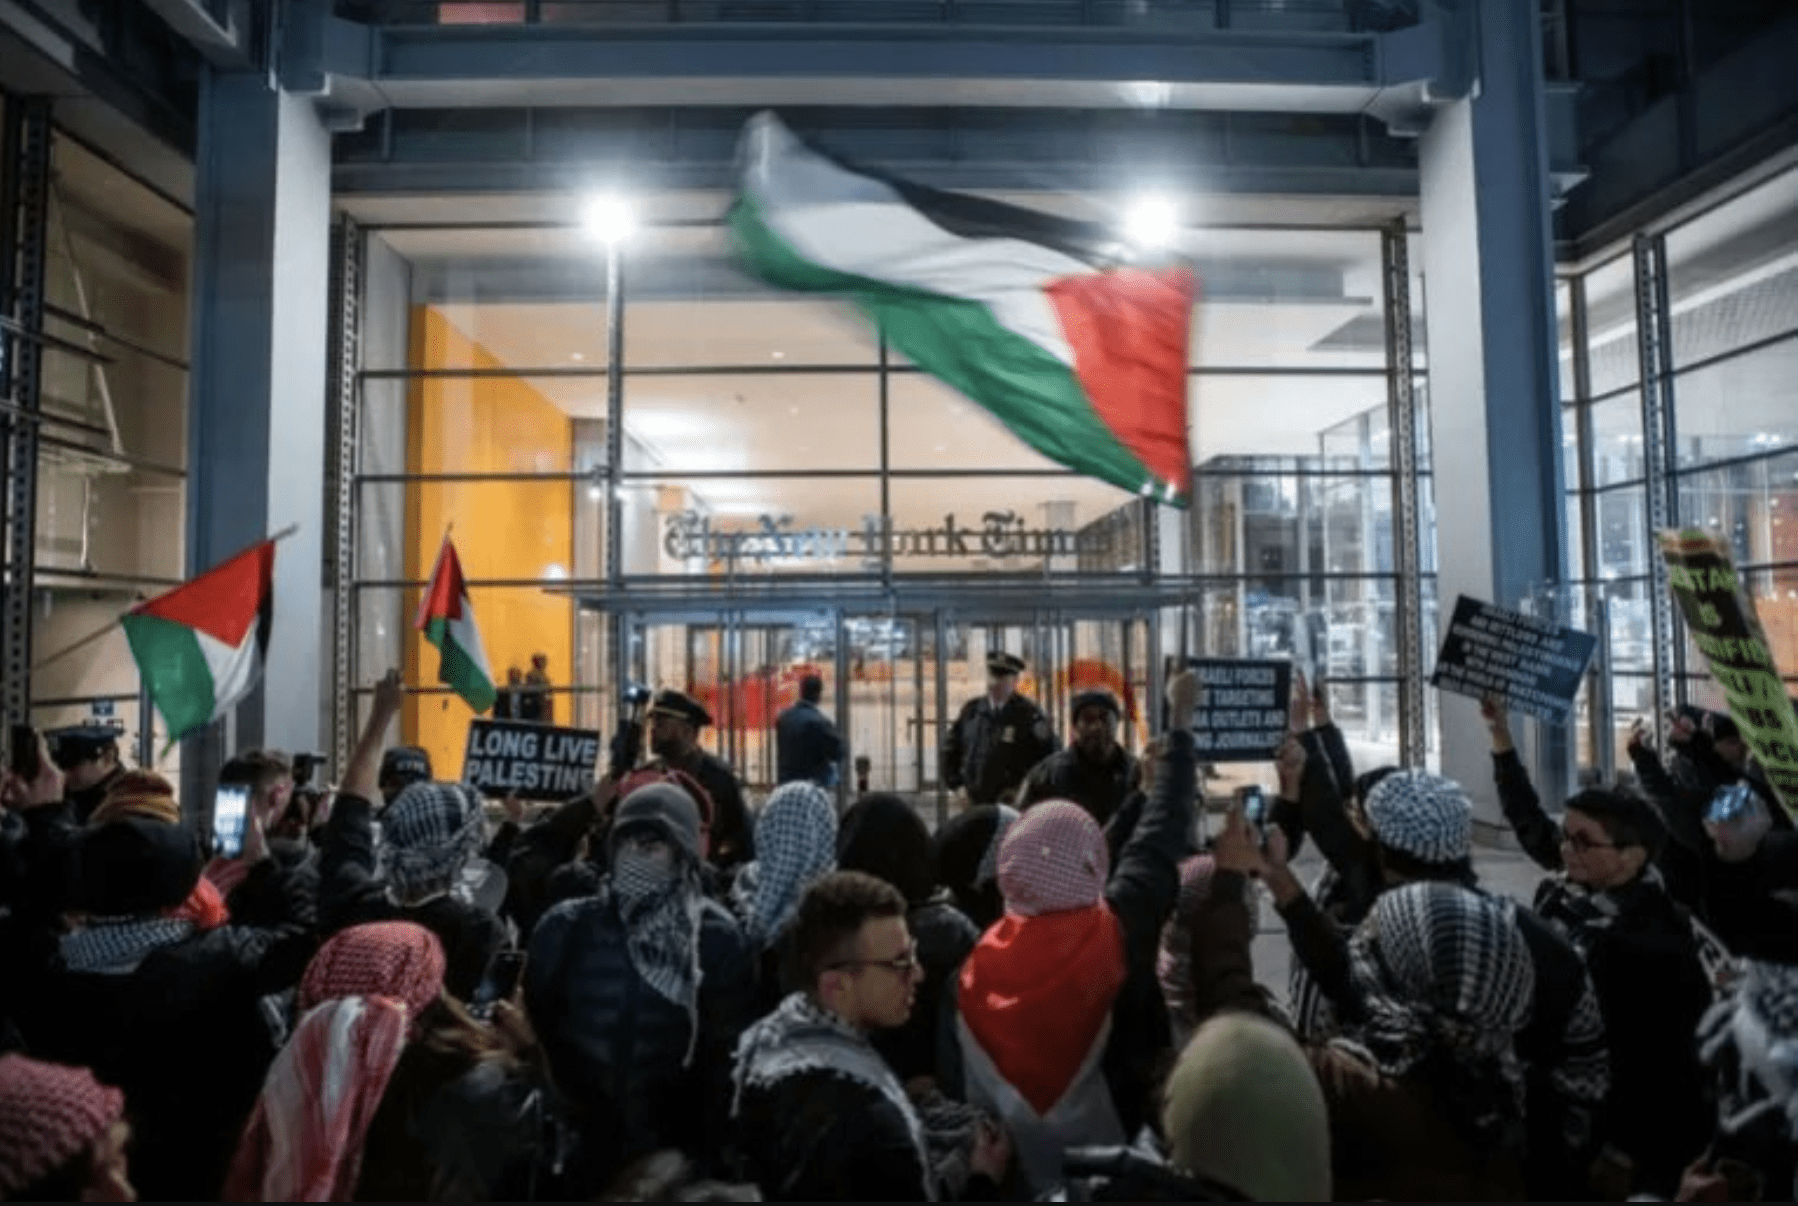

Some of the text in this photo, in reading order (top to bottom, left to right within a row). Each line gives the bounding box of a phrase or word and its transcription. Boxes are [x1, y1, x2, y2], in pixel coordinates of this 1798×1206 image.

[981, 509, 1102, 564] Tim
[470, 729, 598, 763] LONG LIVE
